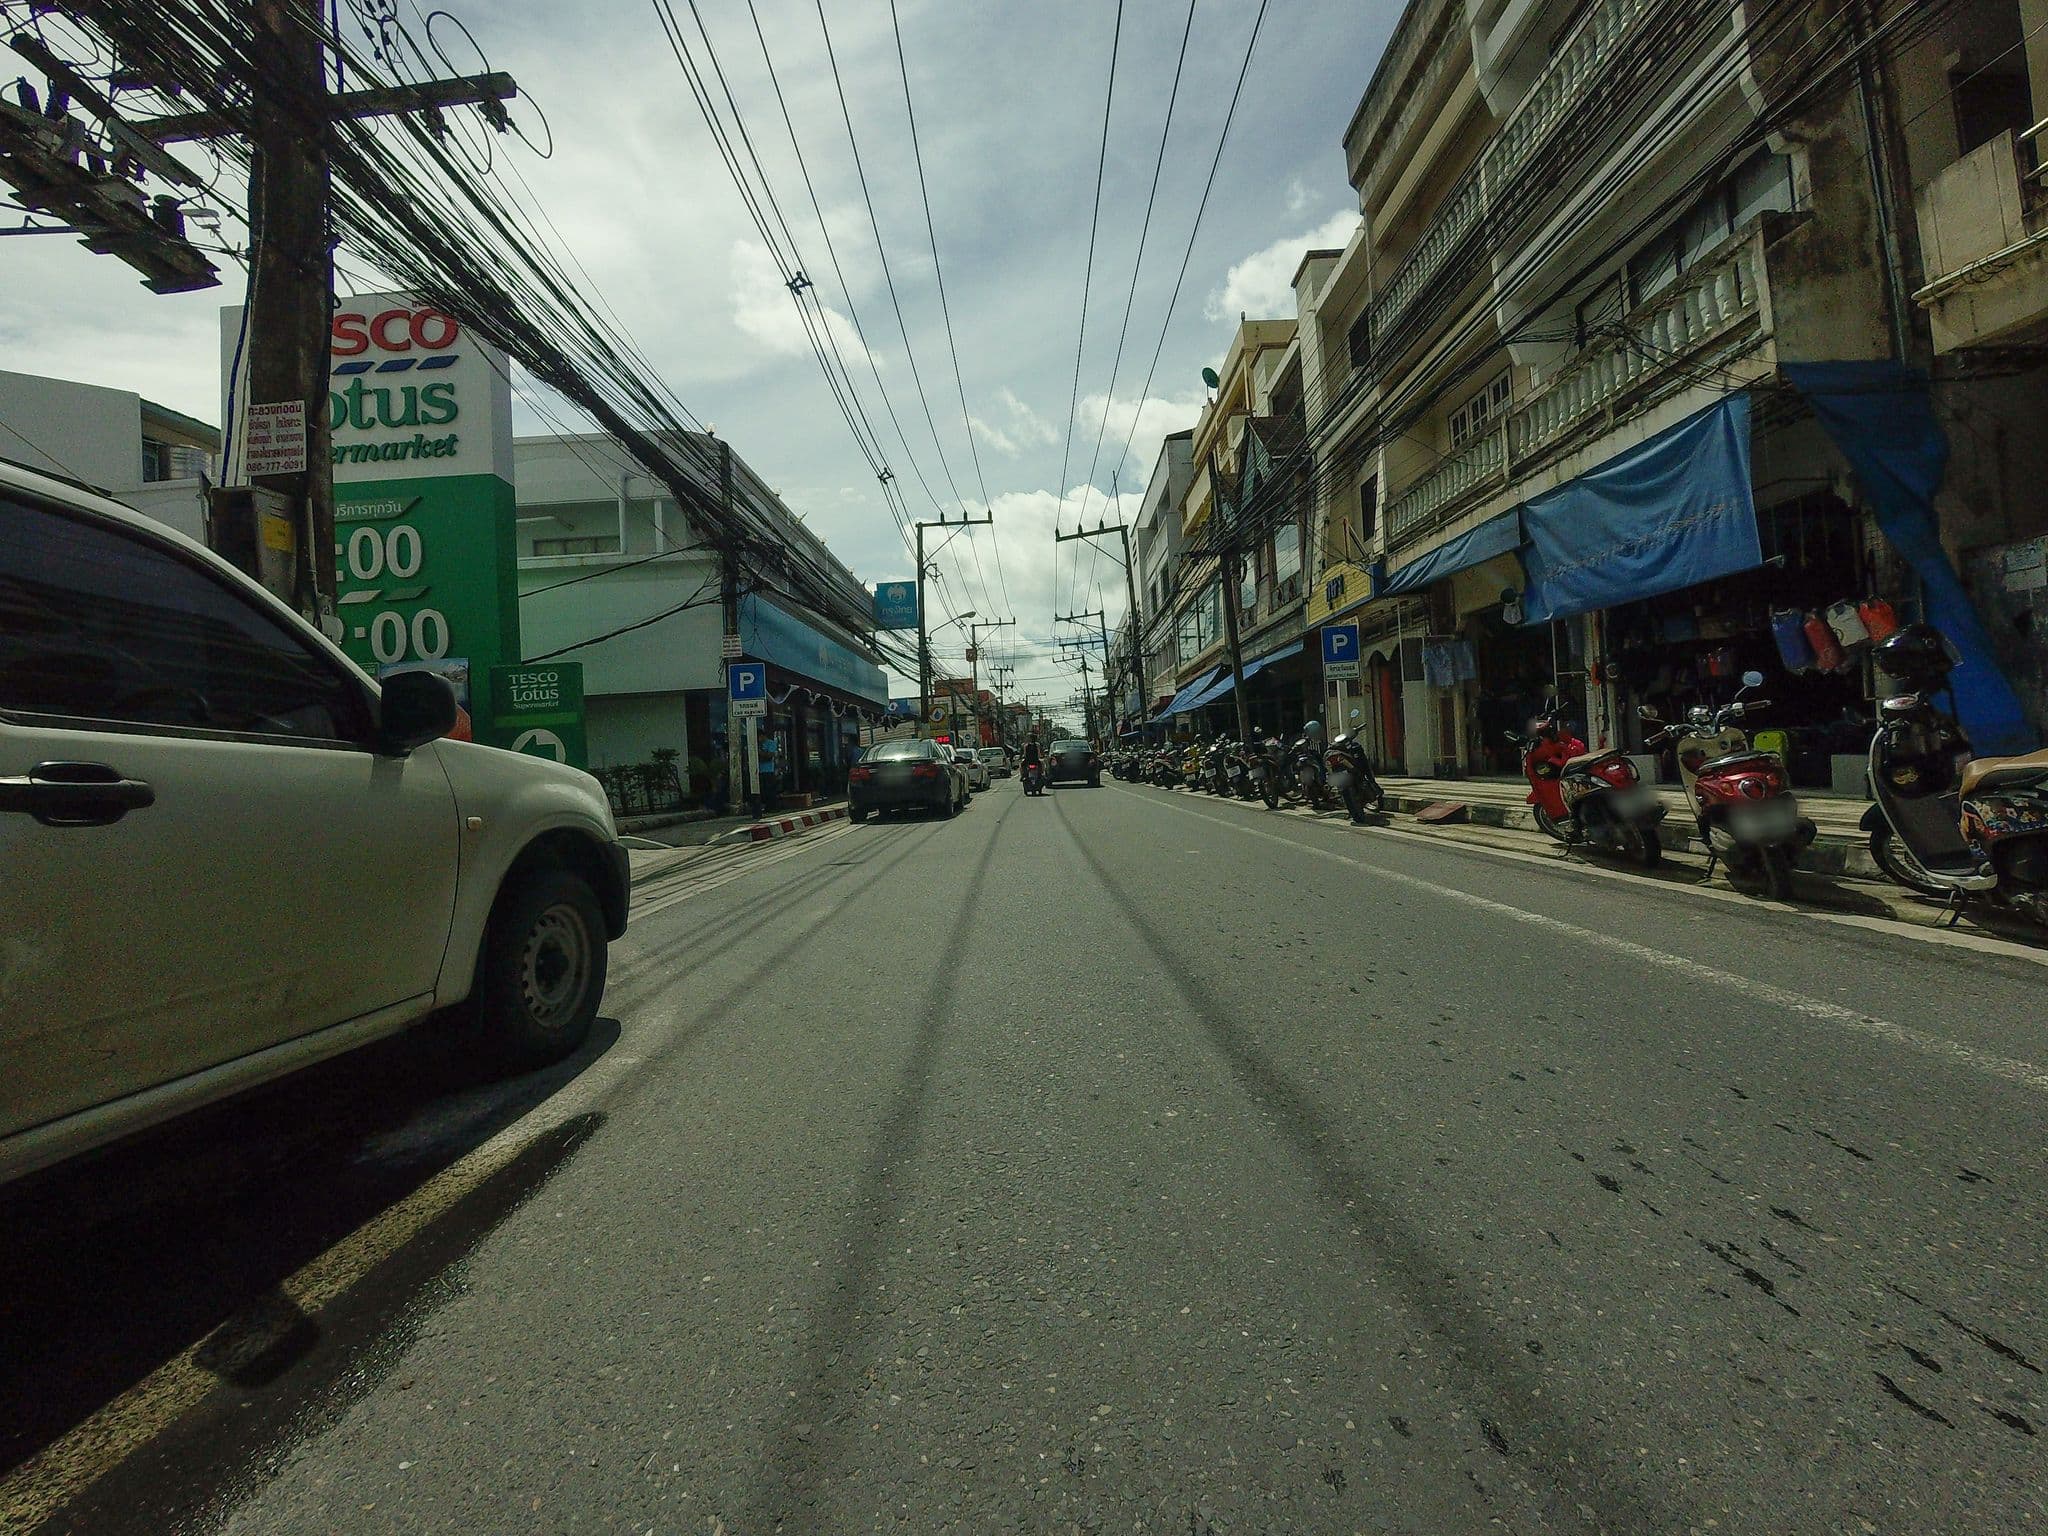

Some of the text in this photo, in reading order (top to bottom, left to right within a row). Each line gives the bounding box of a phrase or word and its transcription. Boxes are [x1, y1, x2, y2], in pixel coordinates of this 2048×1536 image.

[331, 309, 459, 356] SCO
[330, 377, 458, 430] otus
[330, 434, 458, 464] rmarket
[335, 525, 422, 580] :00
[1332, 634, 1348, 654] P
[508, 672, 559, 684] TESCO
[739, 672, 755, 692] P
[512, 688, 559, 702] Lotus
